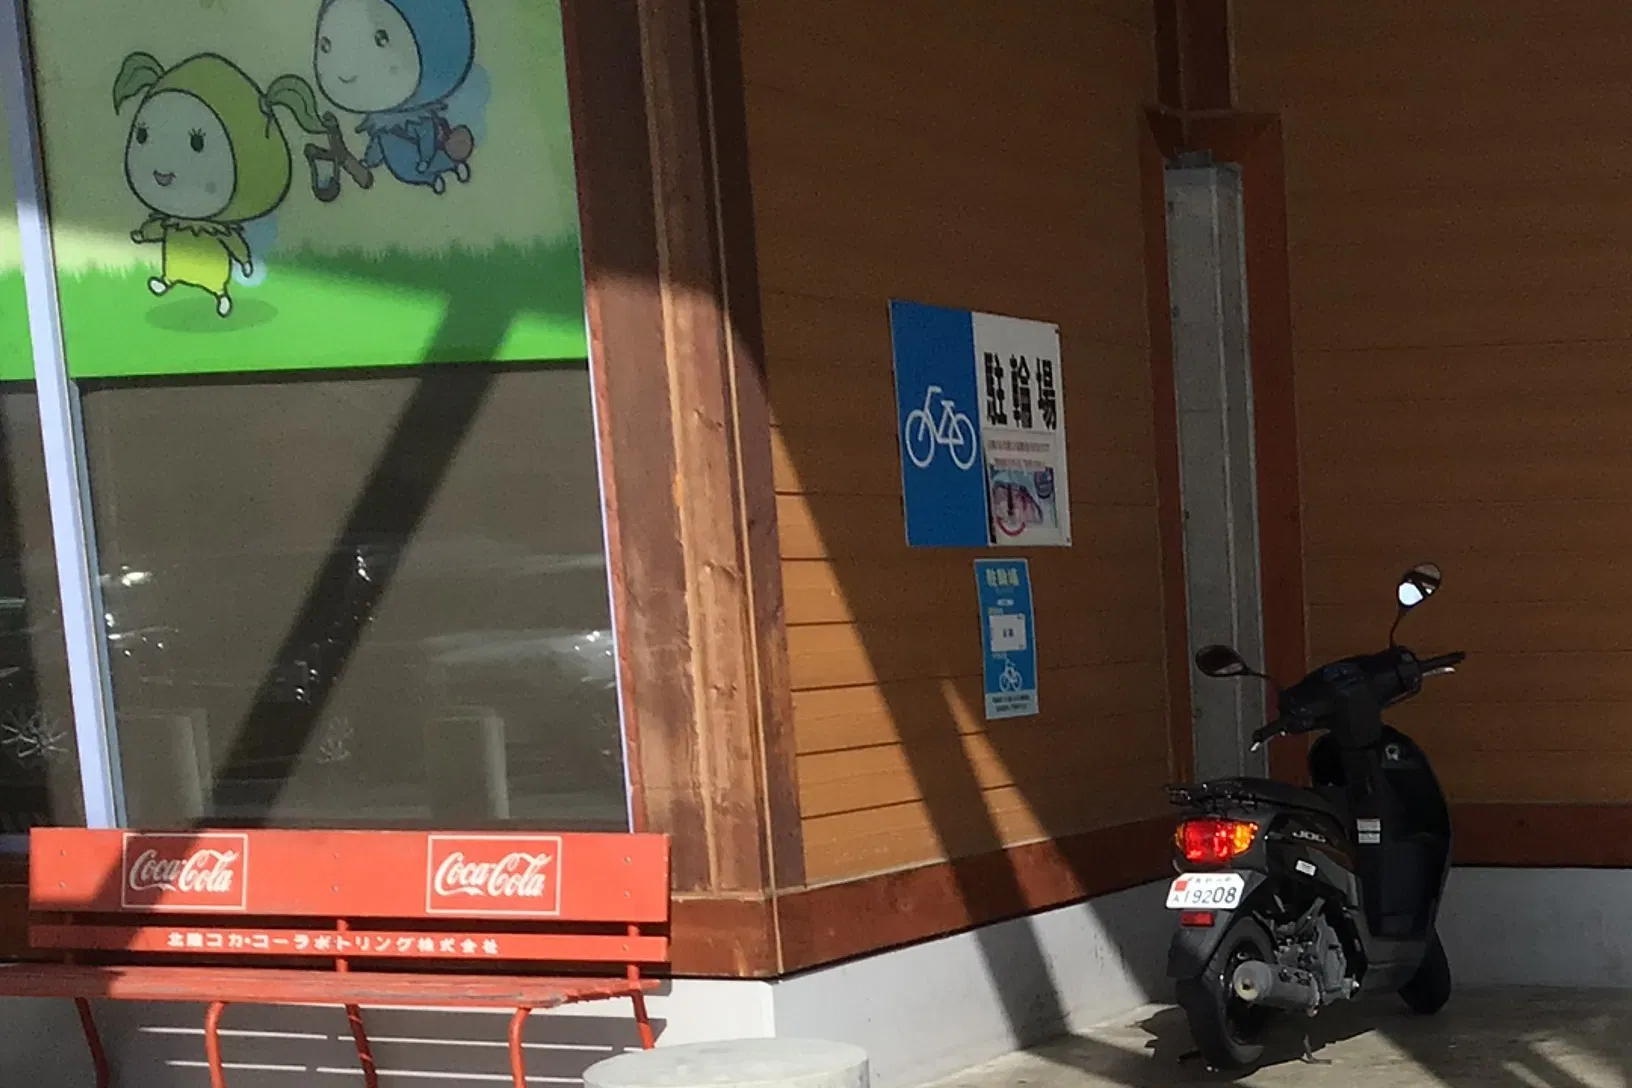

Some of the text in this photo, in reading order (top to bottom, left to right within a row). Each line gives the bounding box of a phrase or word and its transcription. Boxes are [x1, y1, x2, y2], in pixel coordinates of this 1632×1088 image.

[984, 352, 1057, 430] 駐輪場
[129, 848, 241, 892] Coca-Cola
[434, 851, 553, 897] Coca-Cola
